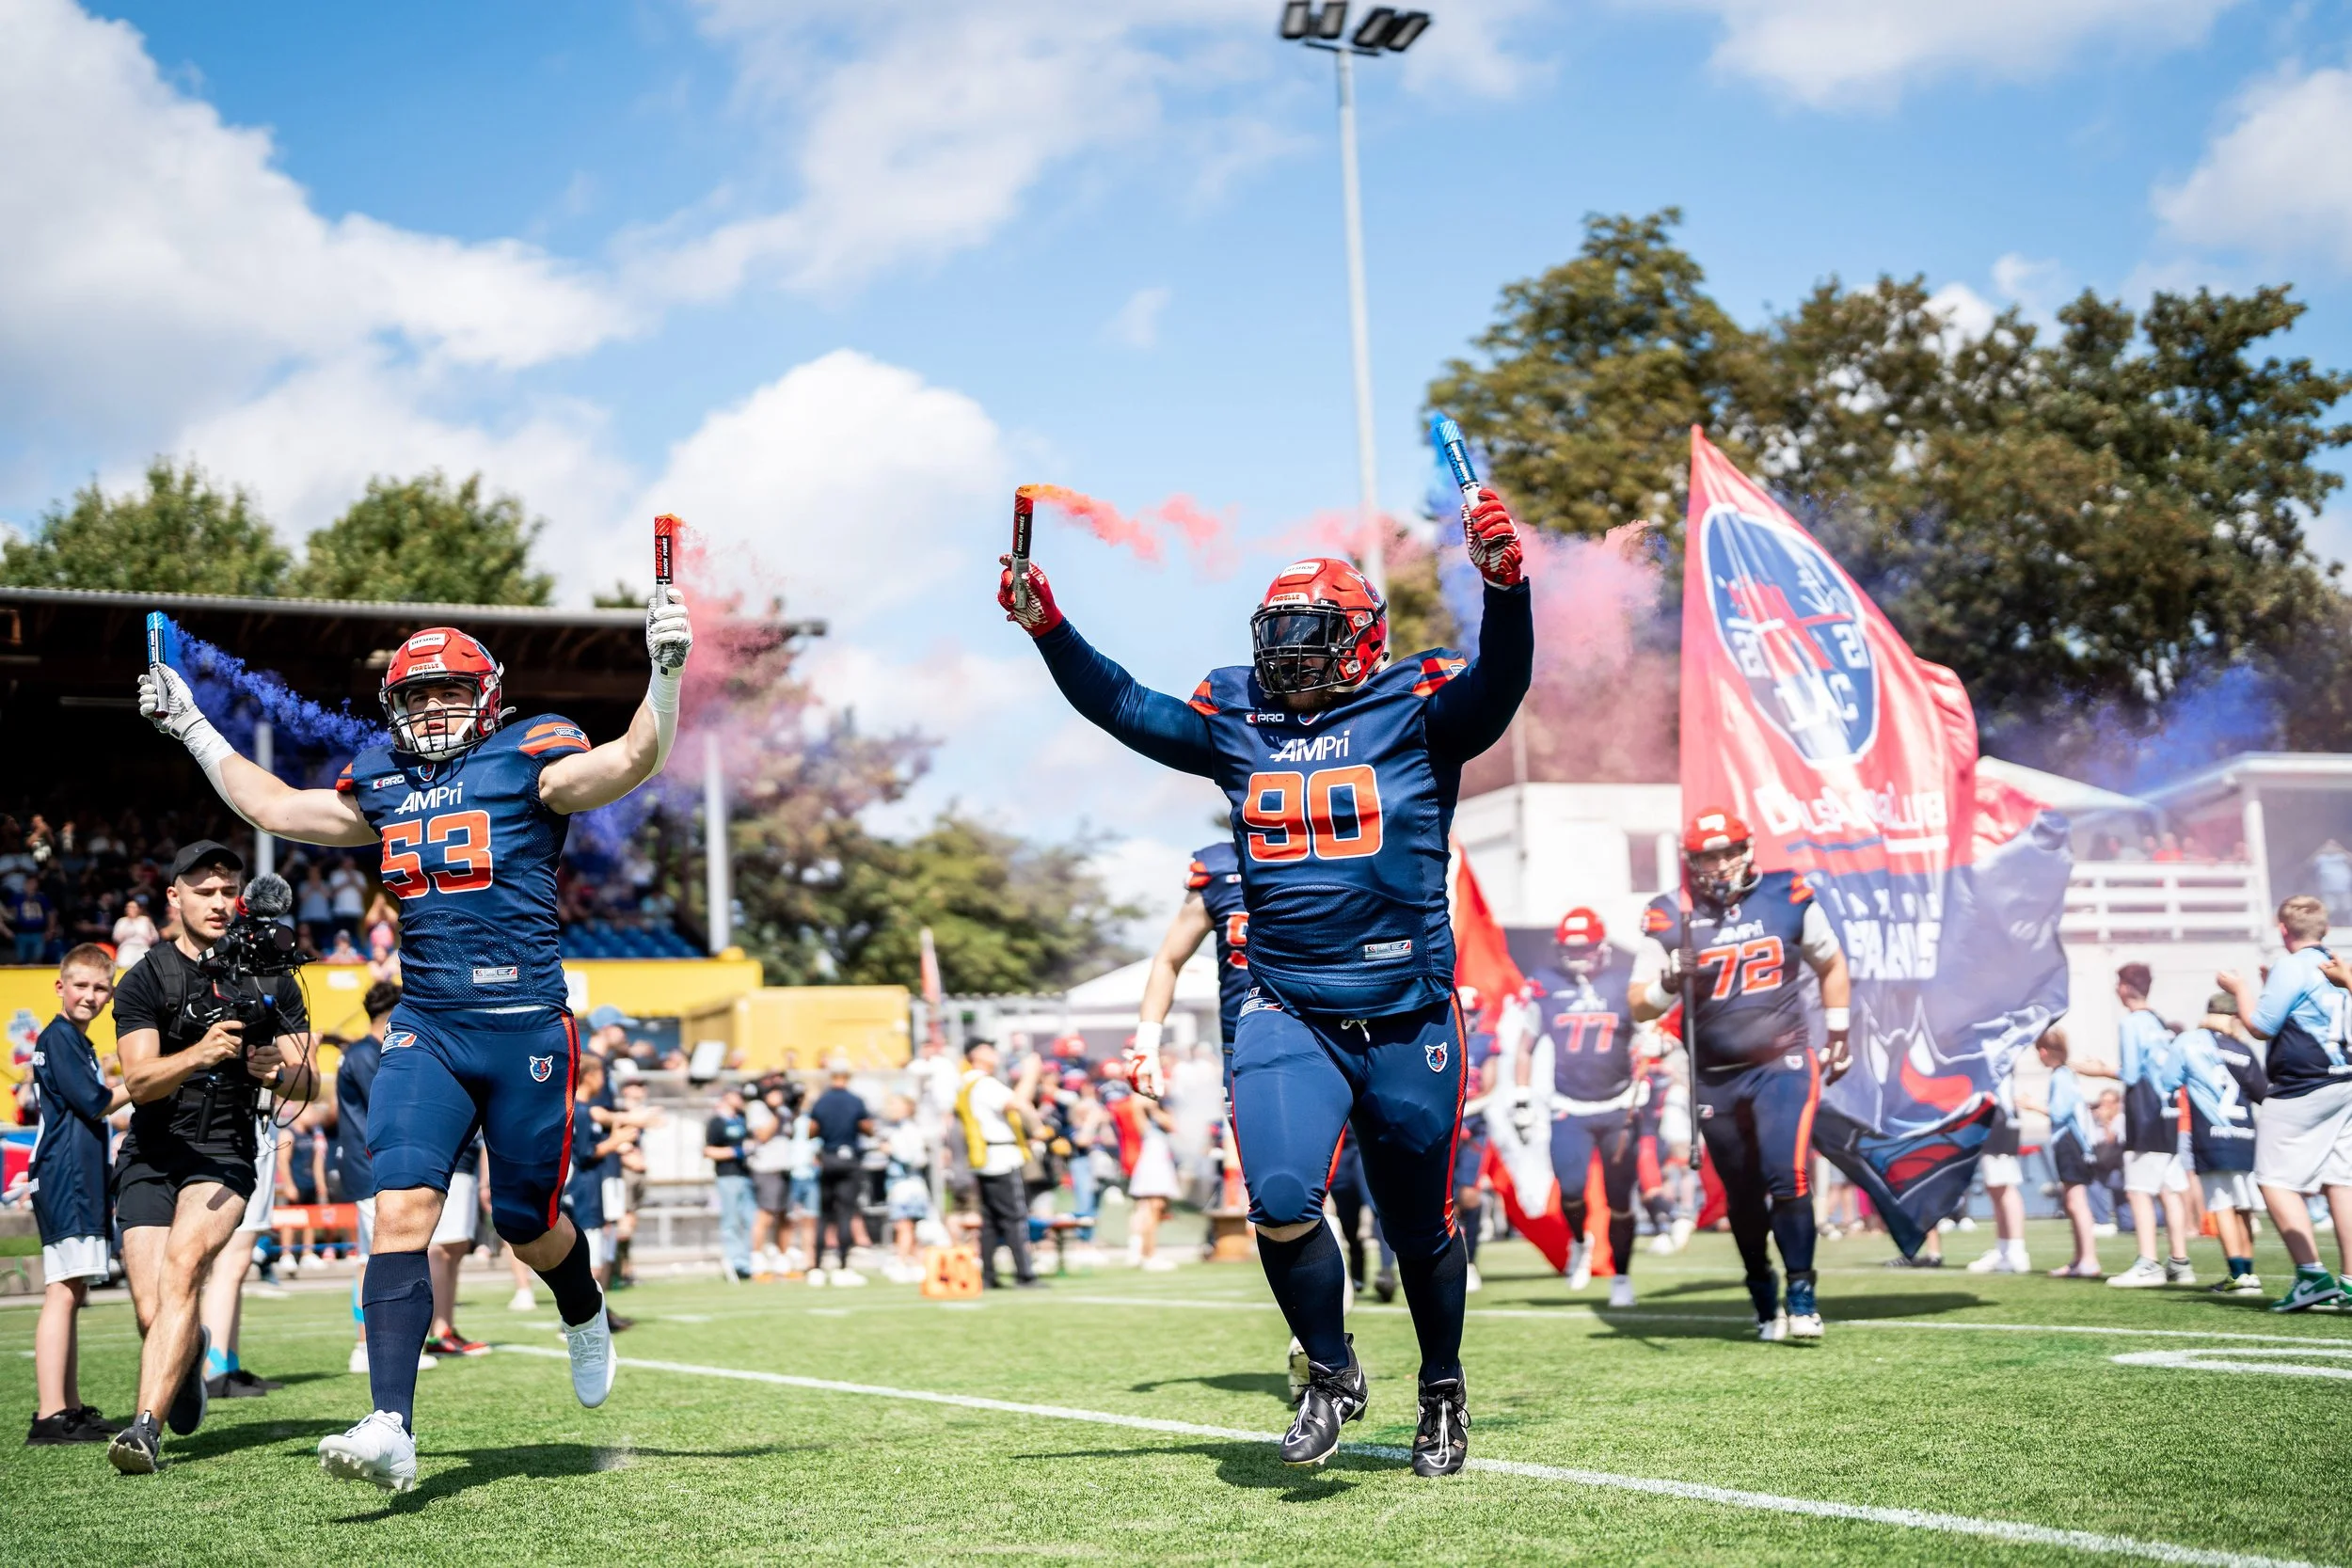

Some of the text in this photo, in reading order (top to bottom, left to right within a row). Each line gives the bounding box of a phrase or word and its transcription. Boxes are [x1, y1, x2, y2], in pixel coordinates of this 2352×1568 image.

[1269, 730, 1350, 762] AMPri
[394, 781, 464, 816] AMPri
[1243, 764, 1383, 863] 90
[380, 810, 493, 900] 53
[1697, 935, 1785, 1001] 72
[1554, 1011, 1620, 1054] 77
